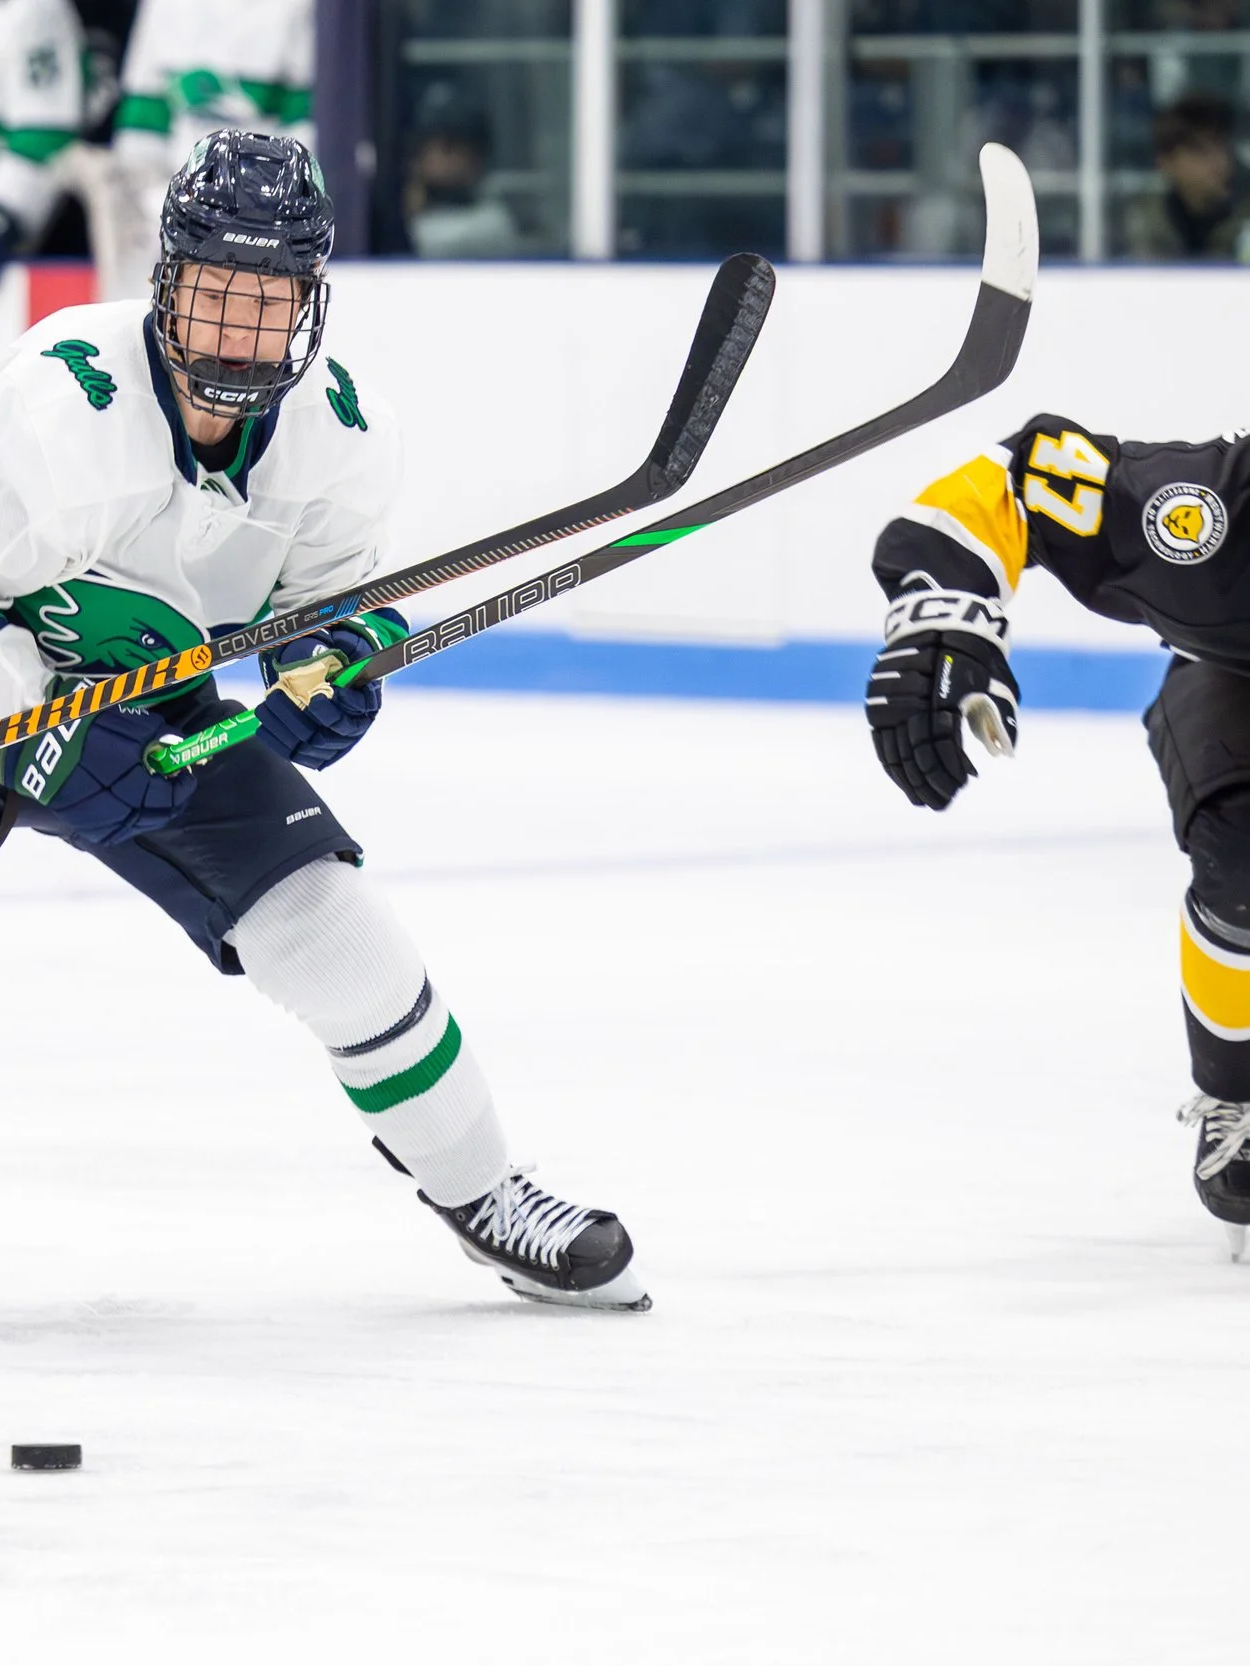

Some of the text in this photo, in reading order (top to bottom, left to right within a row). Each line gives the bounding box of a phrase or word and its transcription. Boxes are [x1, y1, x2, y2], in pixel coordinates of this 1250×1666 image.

[223, 232, 280, 248] BAUER
[203, 386, 259, 403] CCM
[1023, 430, 1111, 538] 47
[218, 613, 300, 658] COVERT
[181, 732, 228, 763] BAUER
[285, 806, 323, 826] BAUER
